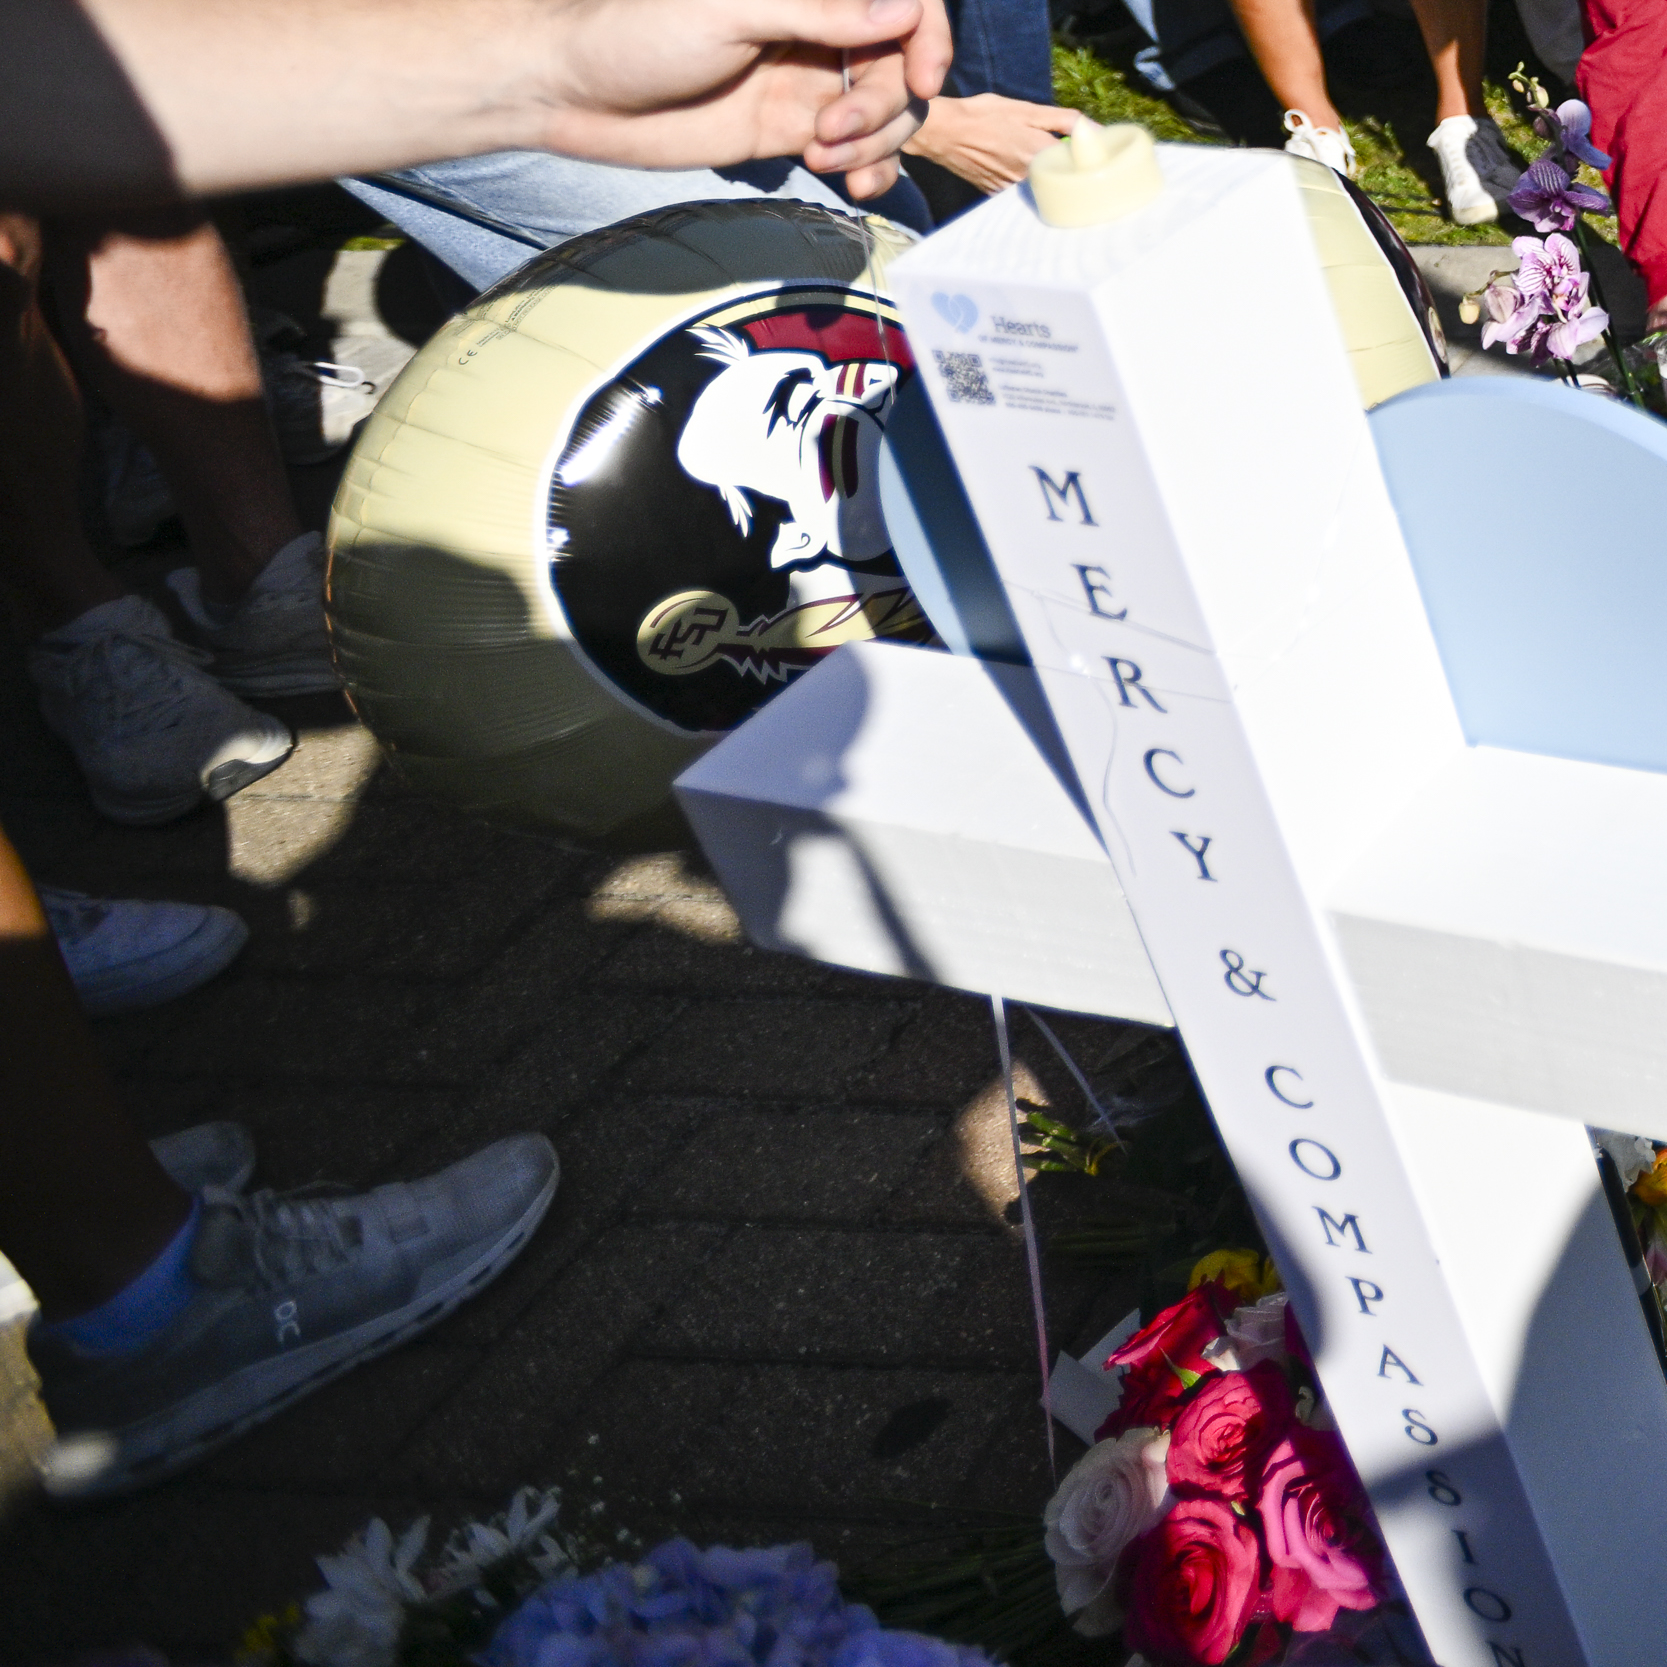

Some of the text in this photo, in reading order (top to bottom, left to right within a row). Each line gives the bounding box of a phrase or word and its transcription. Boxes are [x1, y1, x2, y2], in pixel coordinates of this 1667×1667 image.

[990, 315, 1051, 339] Hearts
[1029, 465, 1219, 884] MERCY
[1218, 948, 1276, 1003] &
[1264, 1065, 1525, 1667] COMPASSION
